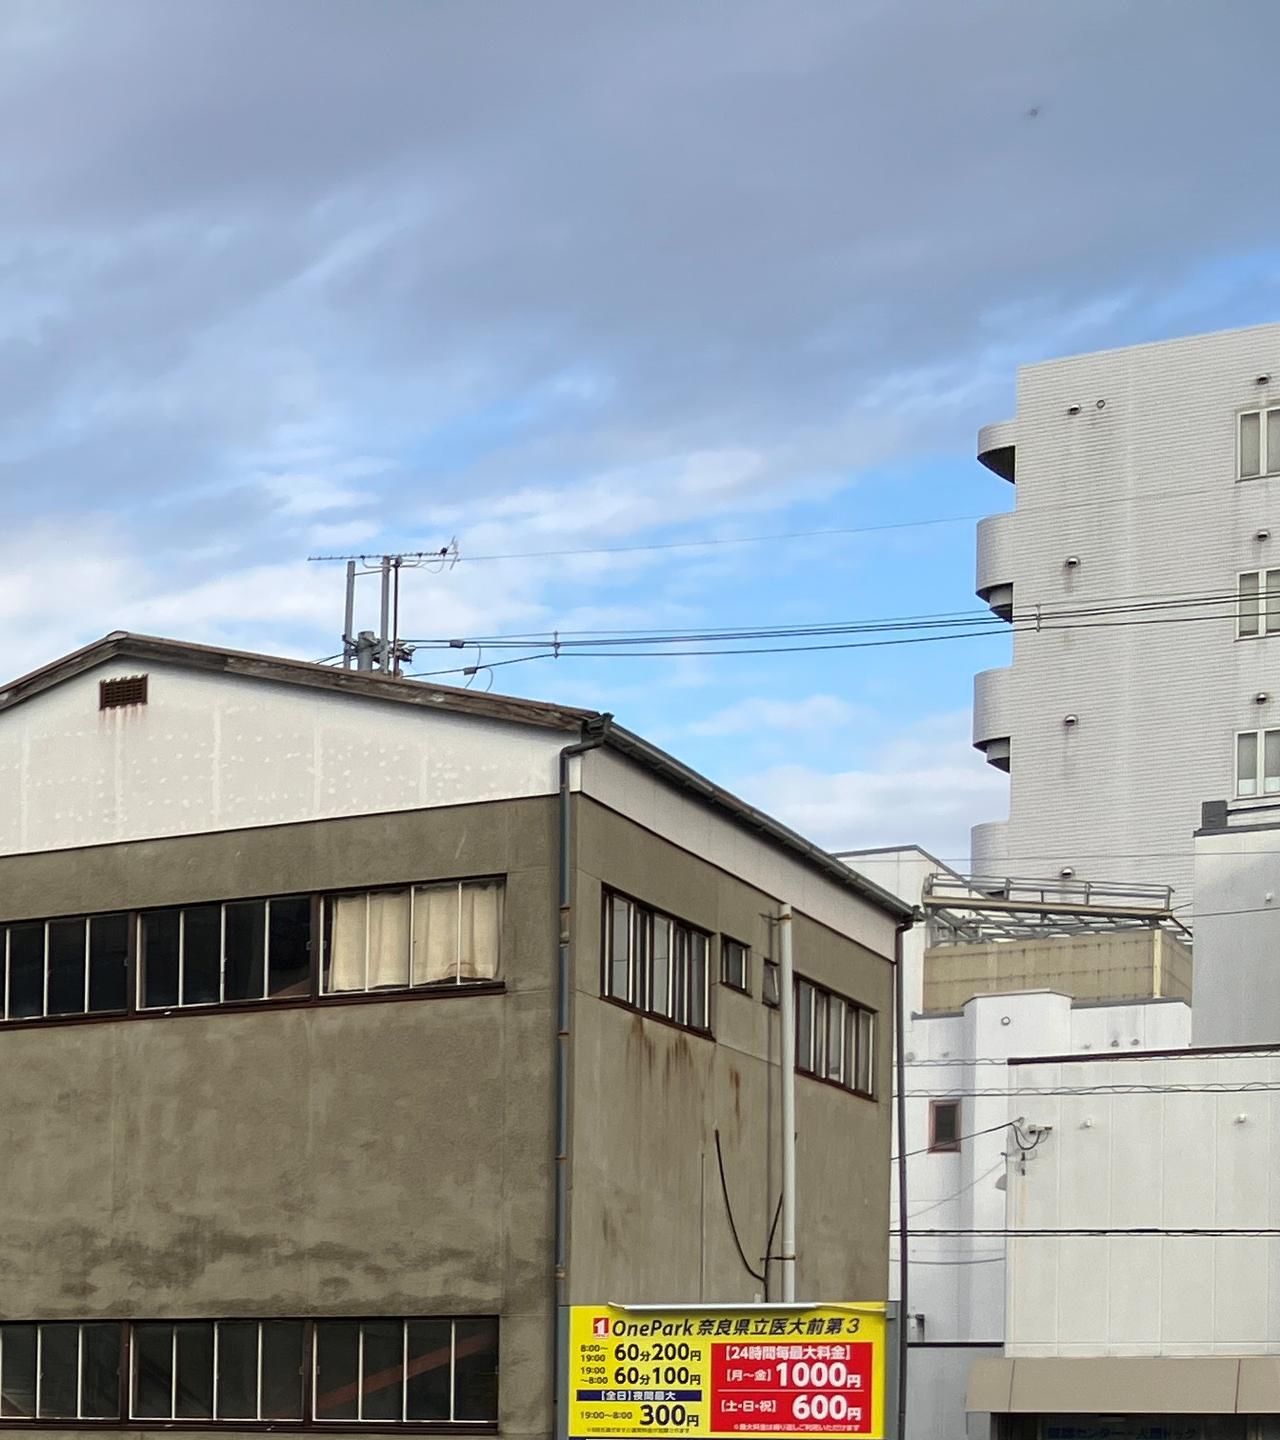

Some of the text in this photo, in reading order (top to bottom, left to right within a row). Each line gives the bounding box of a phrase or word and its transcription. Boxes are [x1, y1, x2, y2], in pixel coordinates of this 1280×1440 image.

[612, 1319, 694, 1337] OnePark
[581, 1354, 606, 1362] 19:00
[581, 1366, 606, 1374] 19:00
[776, 1362, 862, 1388] 1000円
[639, 1404, 700, 1427] 300円
[792, 1394, 862, 1421] 600円
